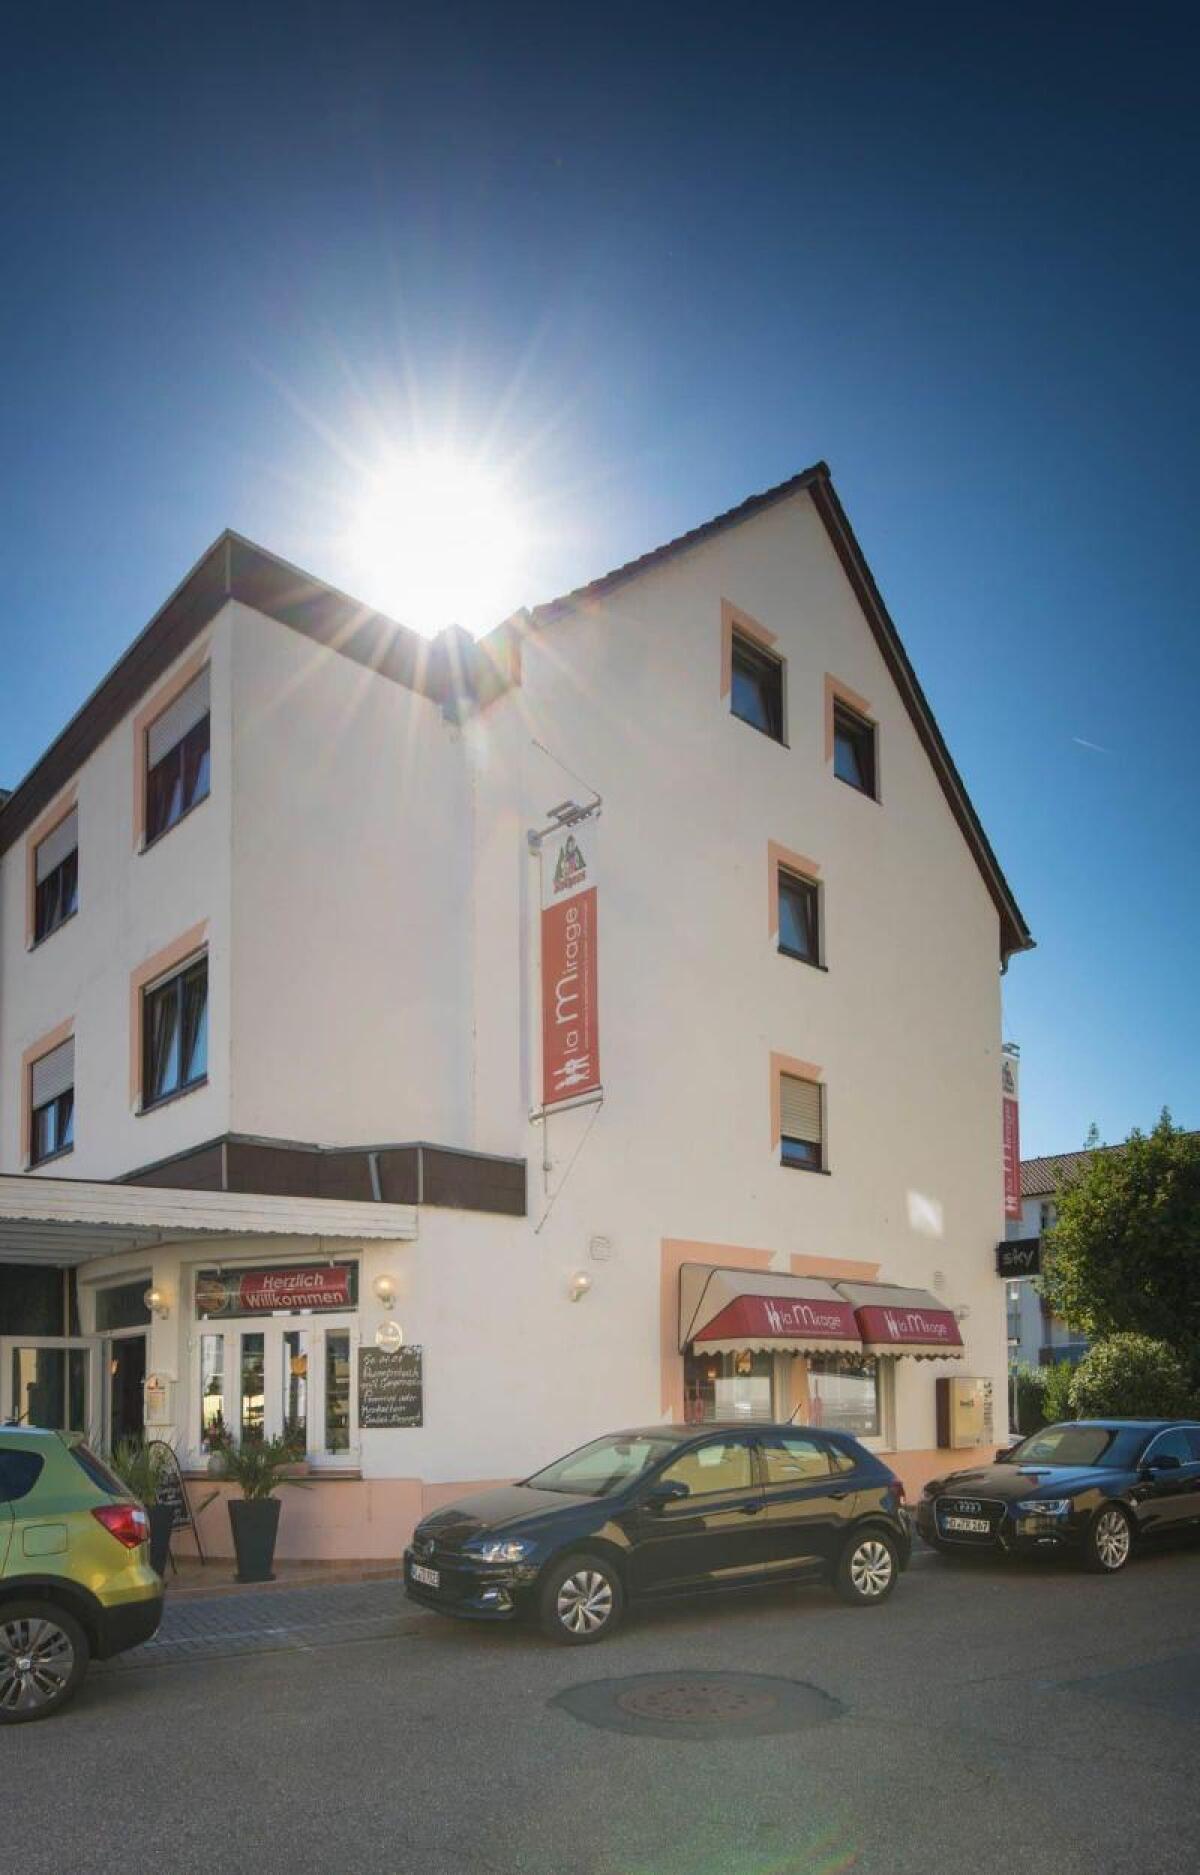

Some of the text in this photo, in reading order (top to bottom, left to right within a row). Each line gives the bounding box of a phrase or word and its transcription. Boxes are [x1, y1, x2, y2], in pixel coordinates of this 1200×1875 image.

[556, 907, 581, 1024] Mirage
[563, 1031, 578, 1055] la
[1003, 1250, 1034, 1268] sky
[263, 1272, 324, 1290] Herzlich
[246, 1291, 343, 1308] Willkommen
[780, 1304, 841, 1330] la Mirage
[905, 1313, 947, 1336] Mirage
